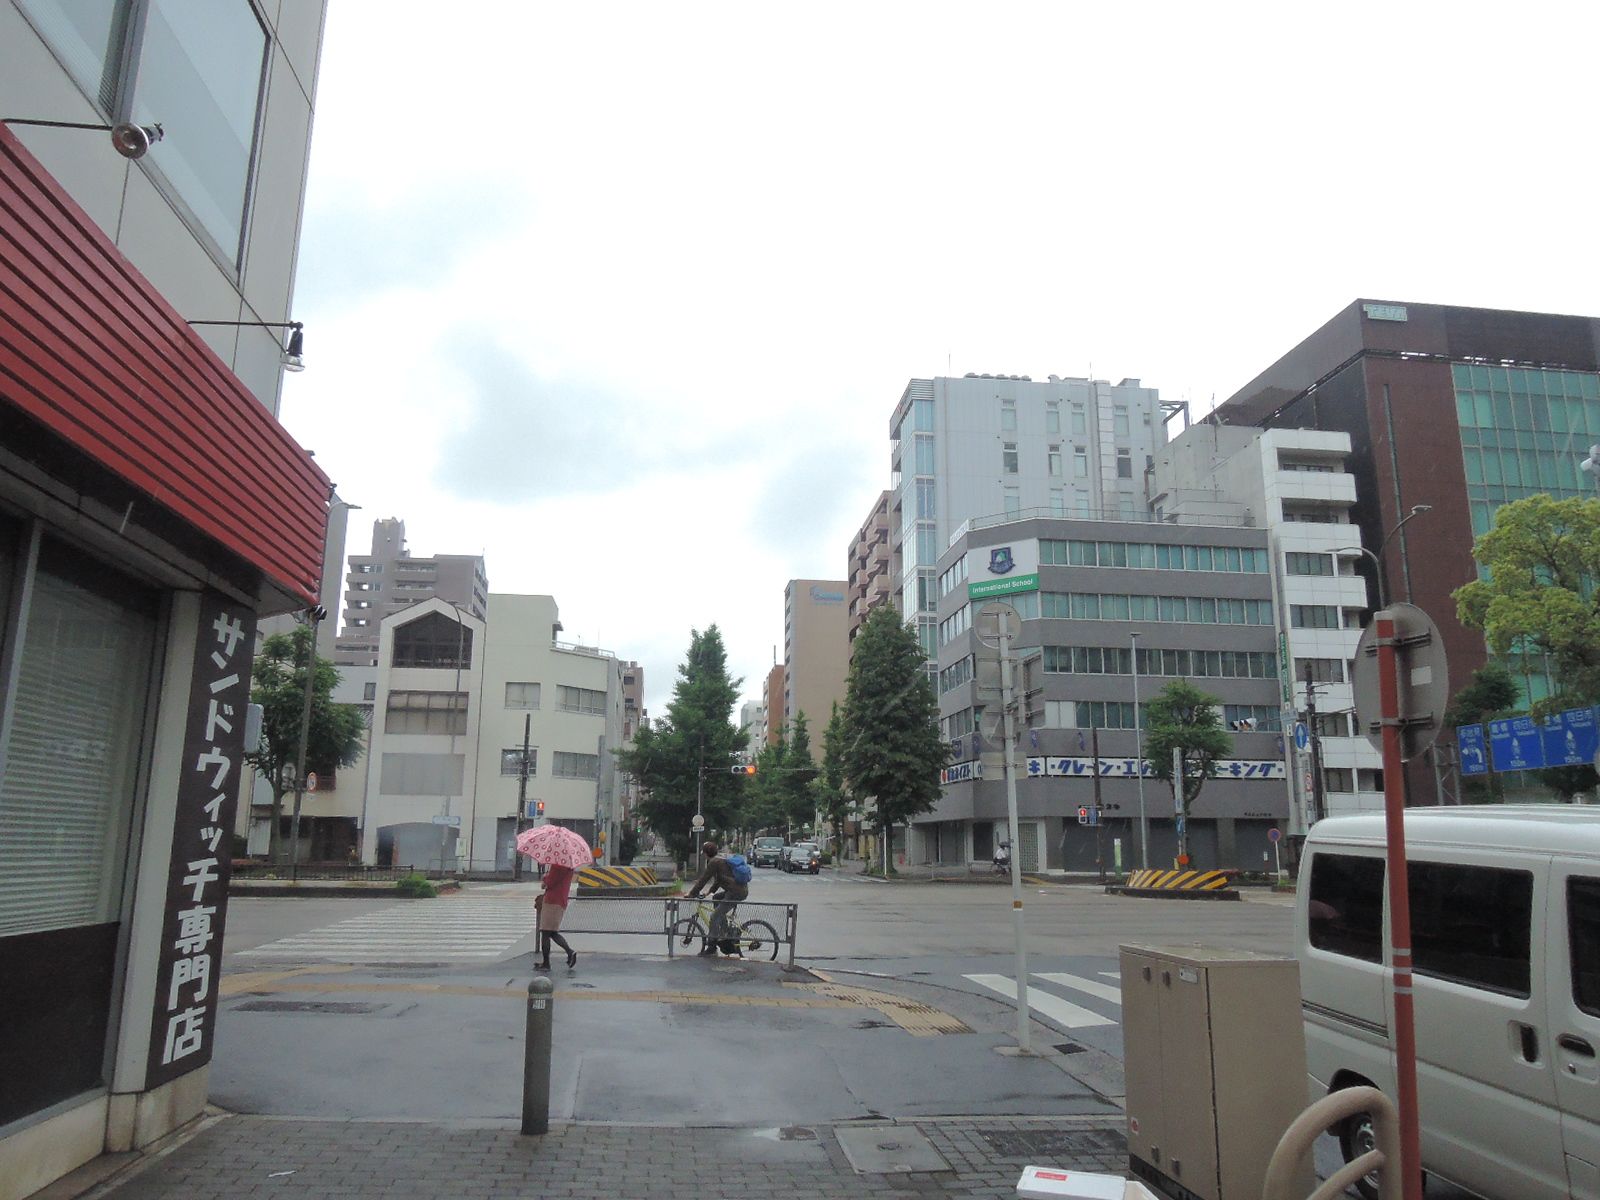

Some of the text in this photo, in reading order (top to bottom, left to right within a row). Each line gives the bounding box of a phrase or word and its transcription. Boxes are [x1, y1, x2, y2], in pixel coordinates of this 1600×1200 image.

[972, 578, 1033, 594] International School
[161, 612, 246, 1066] サンドウィッチ専門店
